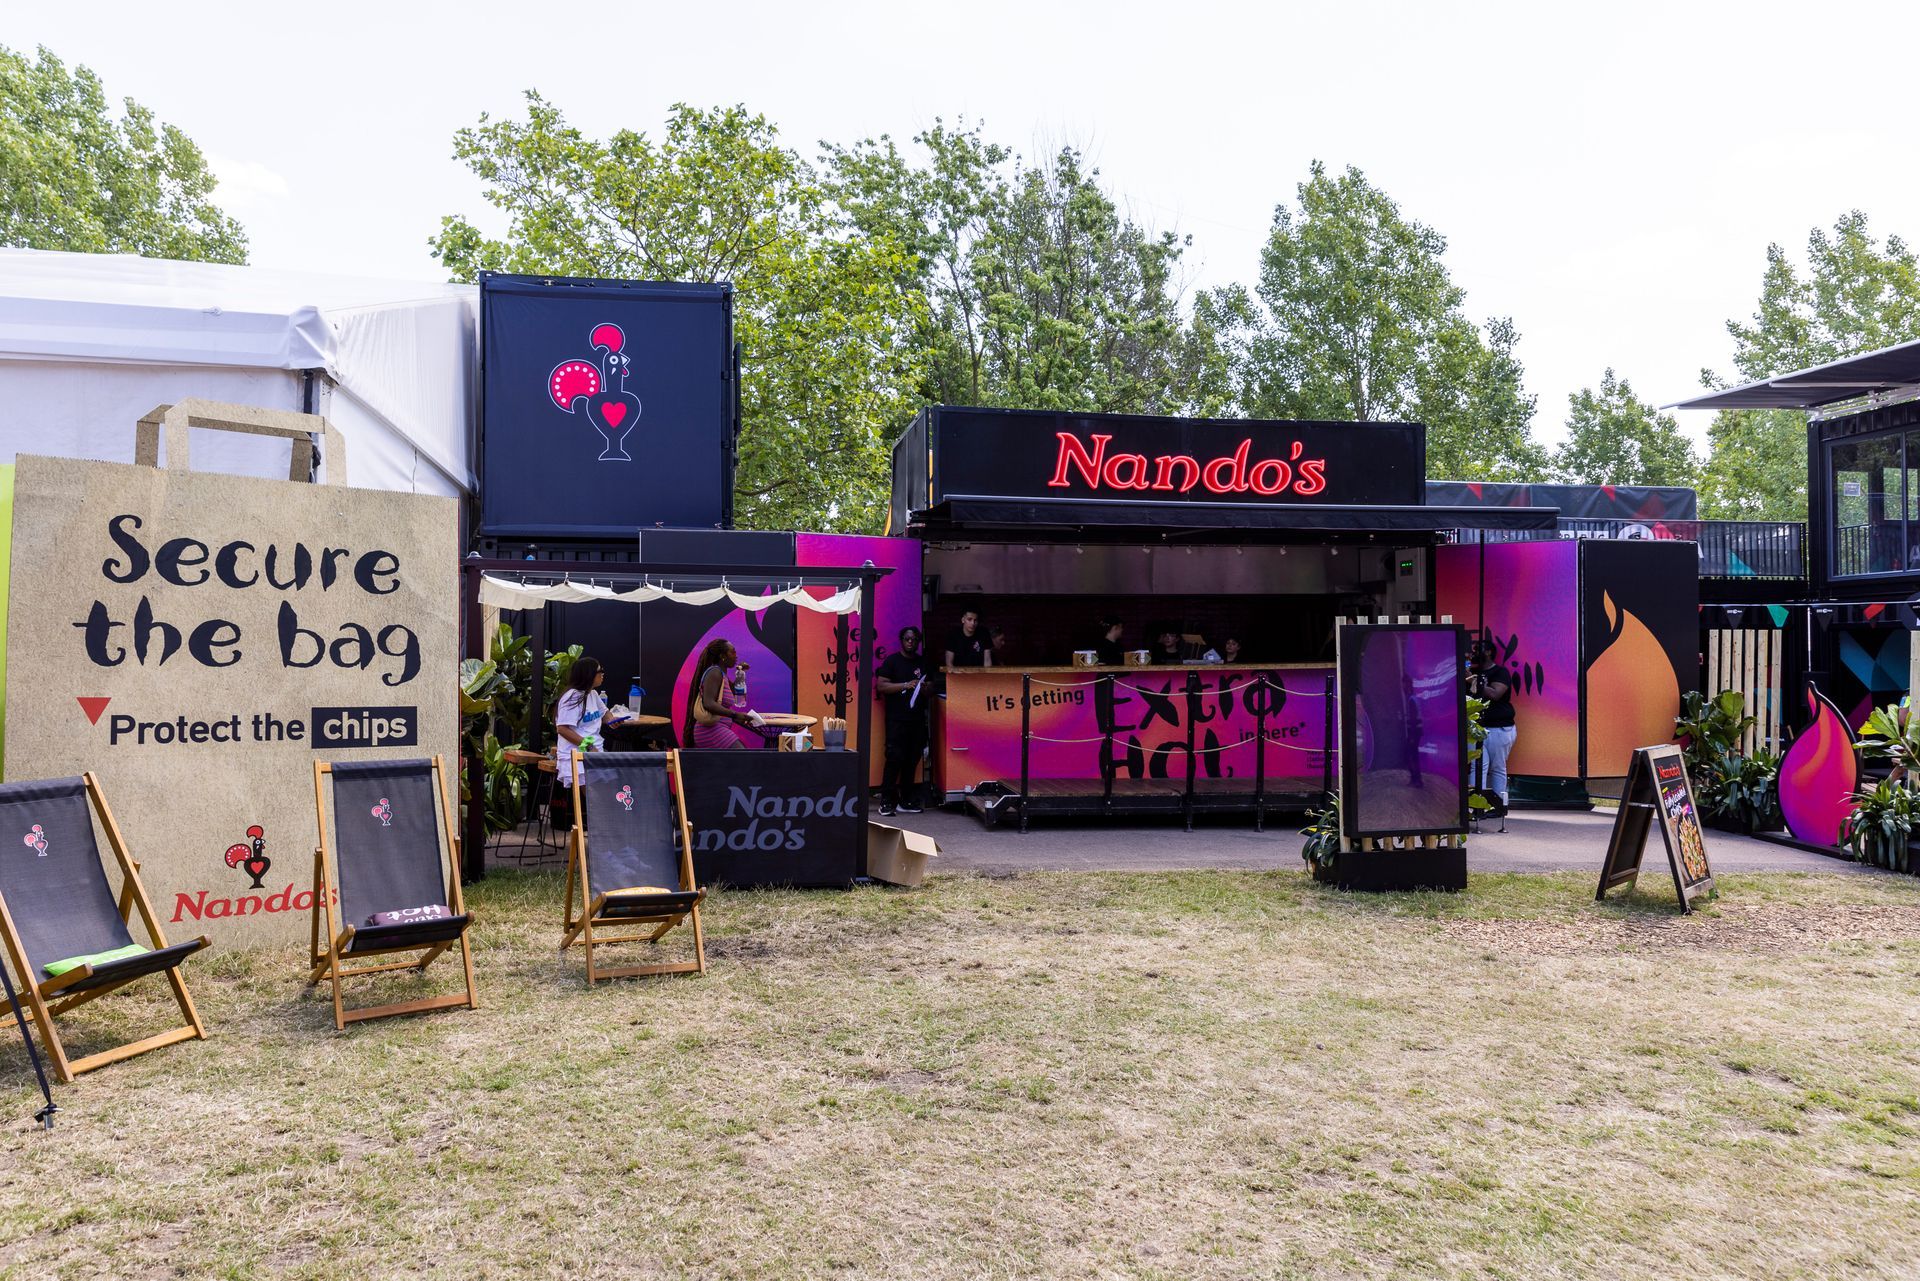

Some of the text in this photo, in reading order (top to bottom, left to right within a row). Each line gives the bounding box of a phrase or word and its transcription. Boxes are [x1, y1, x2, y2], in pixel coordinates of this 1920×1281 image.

[1047, 432, 1327, 496] Nando's
[102, 514, 401, 595] Secure
[72, 595, 422, 687] the bag
[110, 710, 408, 746] Protect the chips
[986, 688, 1085, 712] It's etting
[1094, 670, 1287, 733] Extra
[1099, 728, 1233, 778] Hot
[1239, 728, 1256, 742] in
